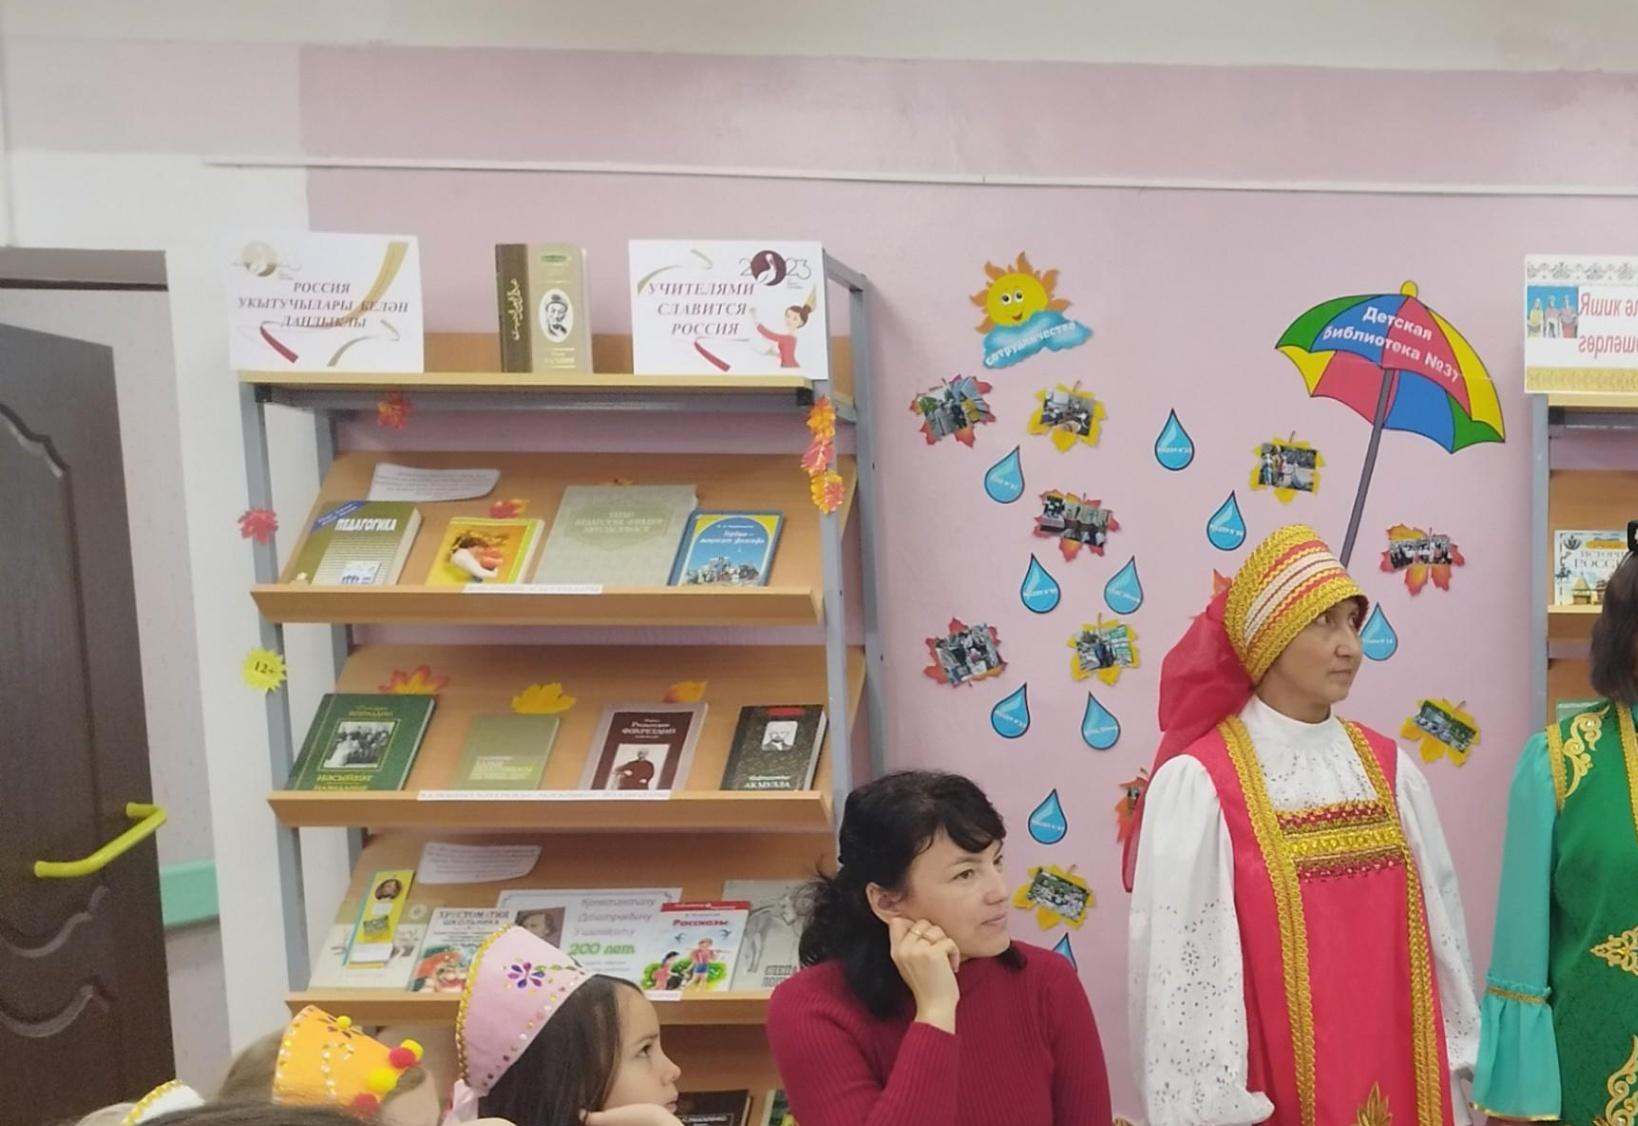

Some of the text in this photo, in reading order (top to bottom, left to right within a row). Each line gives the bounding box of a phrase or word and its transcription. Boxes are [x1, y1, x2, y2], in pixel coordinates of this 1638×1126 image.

[293, 282, 351, 293] РОССИЯ
[648, 283, 755, 295] УЧИТЕЛЯМИ
[238, 297, 352, 311] УКЫТУЧЫЛАРЫ
[657, 303, 747, 315] СЛАВИТСЯ
[1579, 292, 1622, 316] Яшик
[671, 323, 739, 335] РОССИЯ
[1362, 306, 1433, 341] Детская
[334, 518, 398, 531] ПЕДАГОГИКА
[254, 661, 277, 675] 12+
[672, 918, 729, 927] Рассказы
[569, 942, 636, 956] 200 лет
